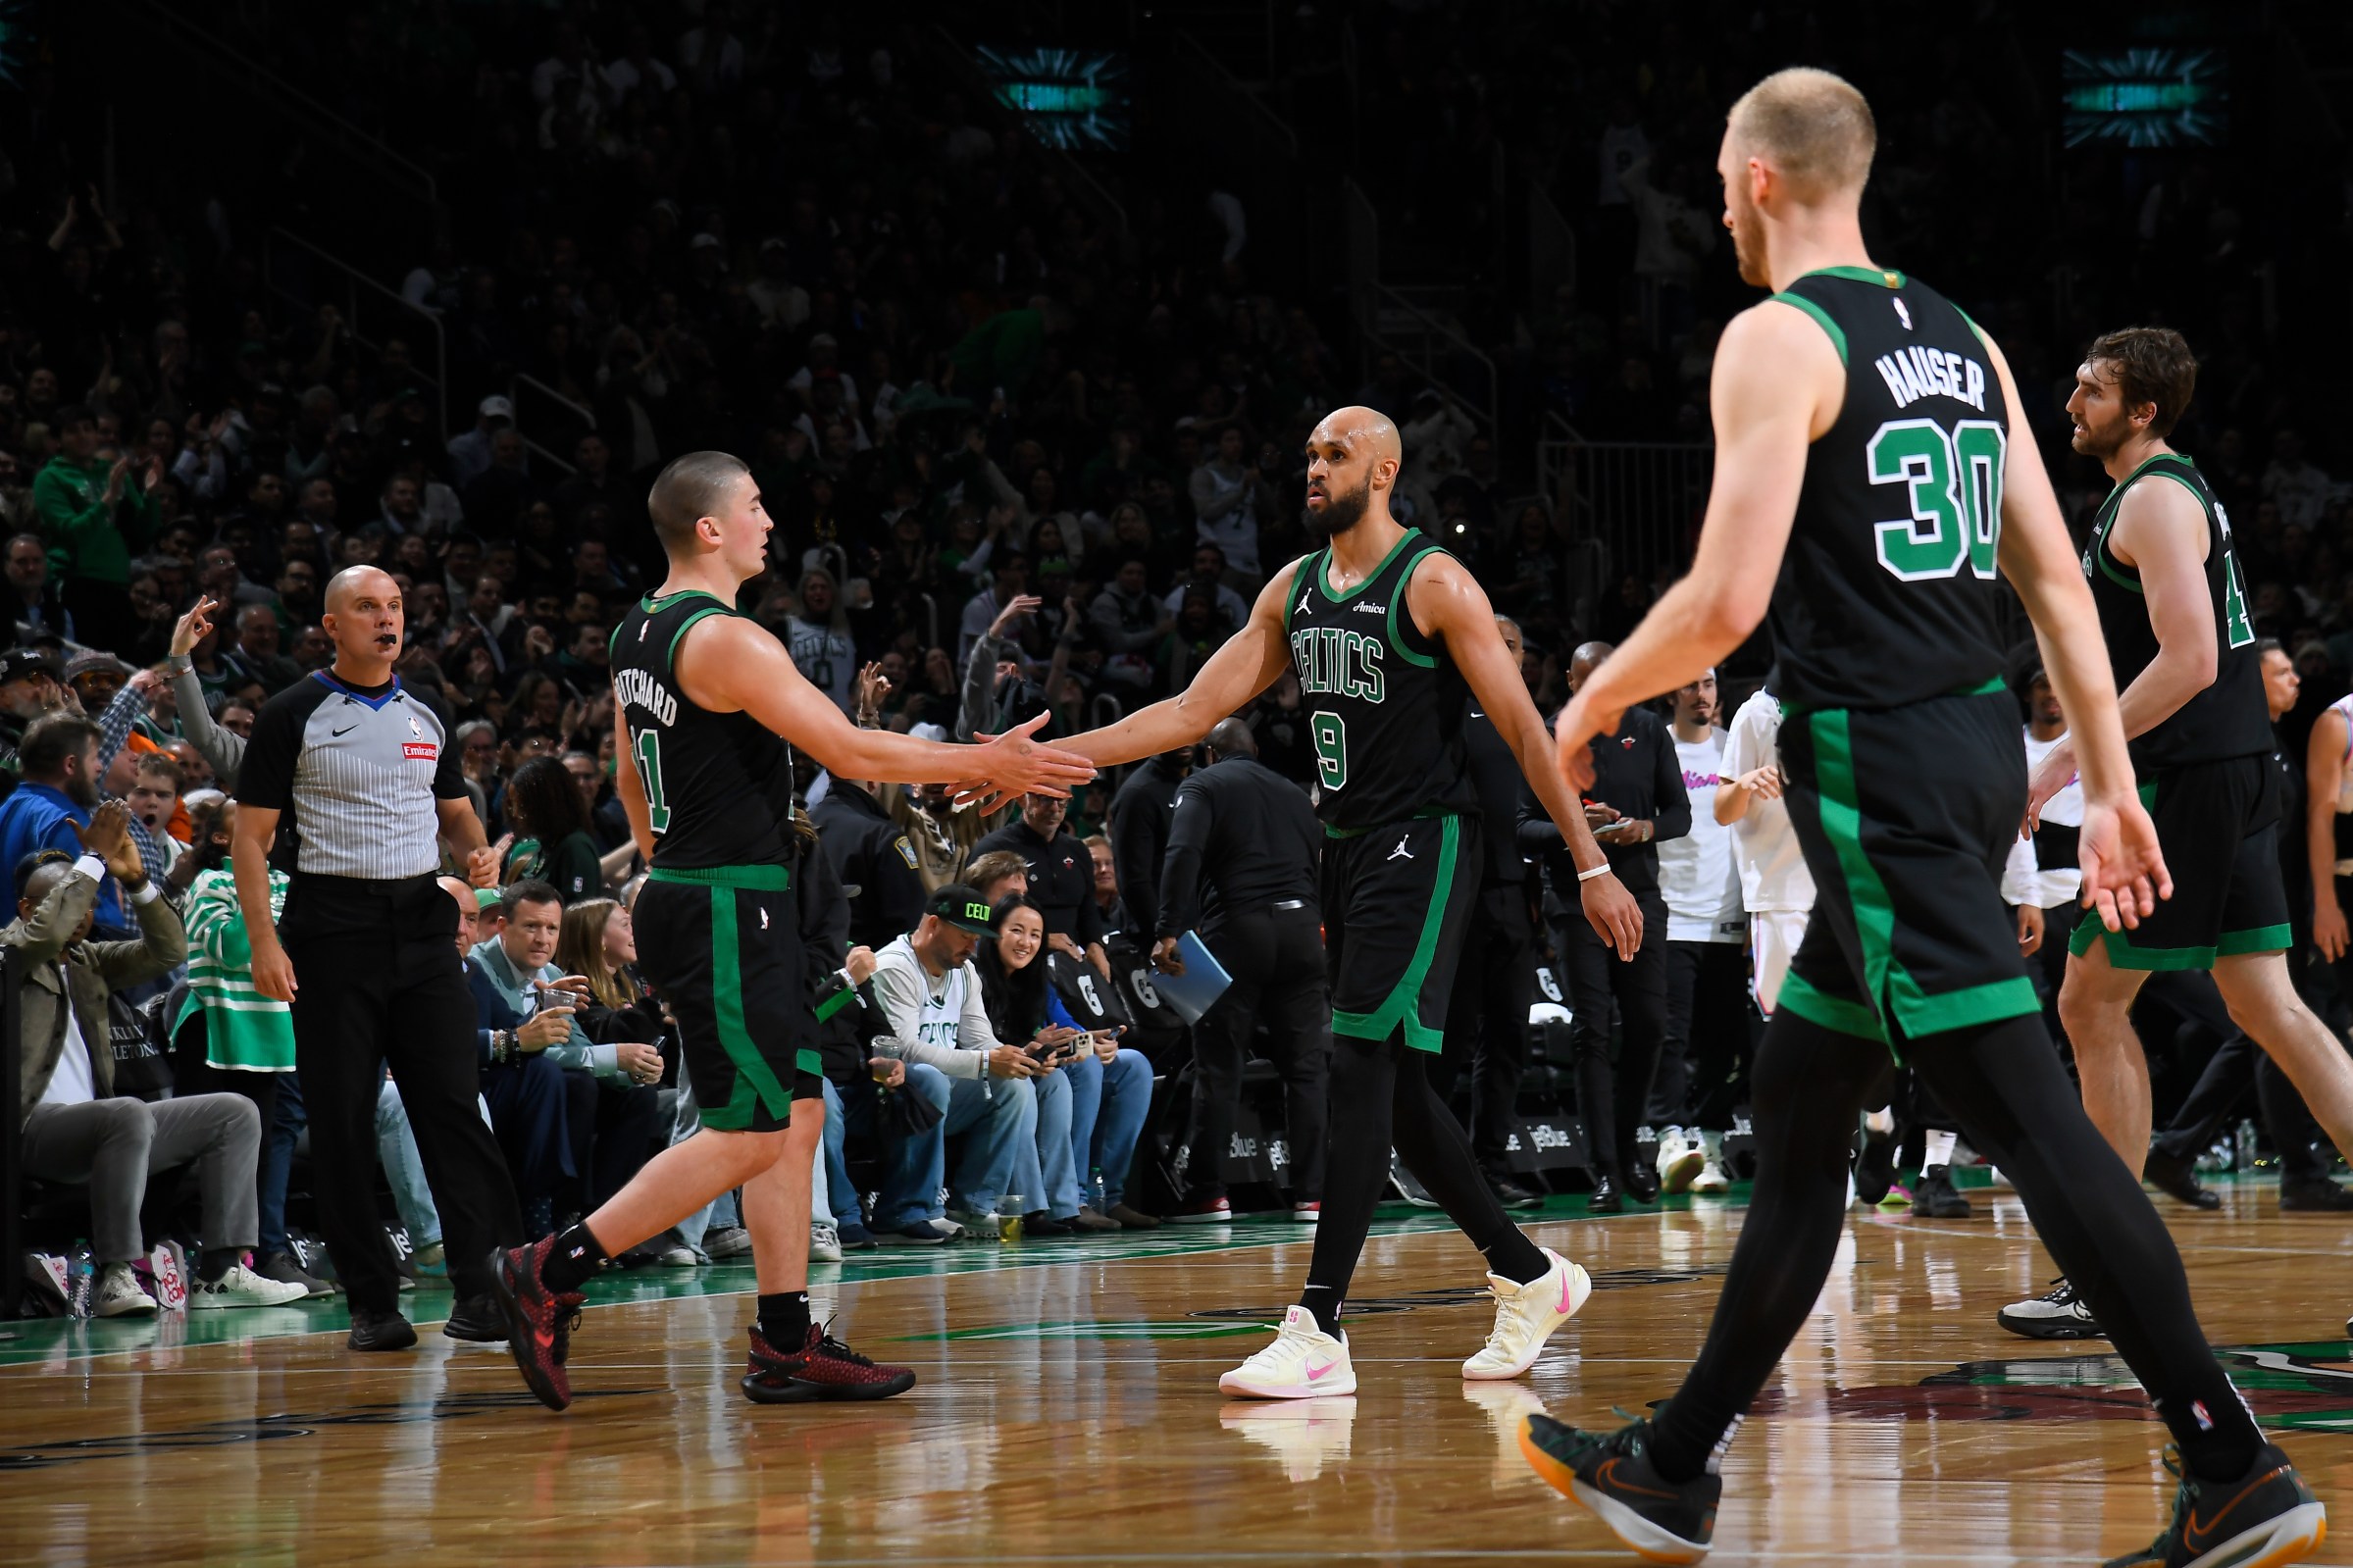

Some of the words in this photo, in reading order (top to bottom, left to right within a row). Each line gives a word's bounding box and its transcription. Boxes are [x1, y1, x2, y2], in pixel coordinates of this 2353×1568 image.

[1874, 345, 1985, 412] HAUSER
[1867, 417, 2007, 582] 30
[1353, 601, 1386, 615] Amica
[403, 746, 436, 757] Emirates
[1310, 711, 1347, 791] 9
